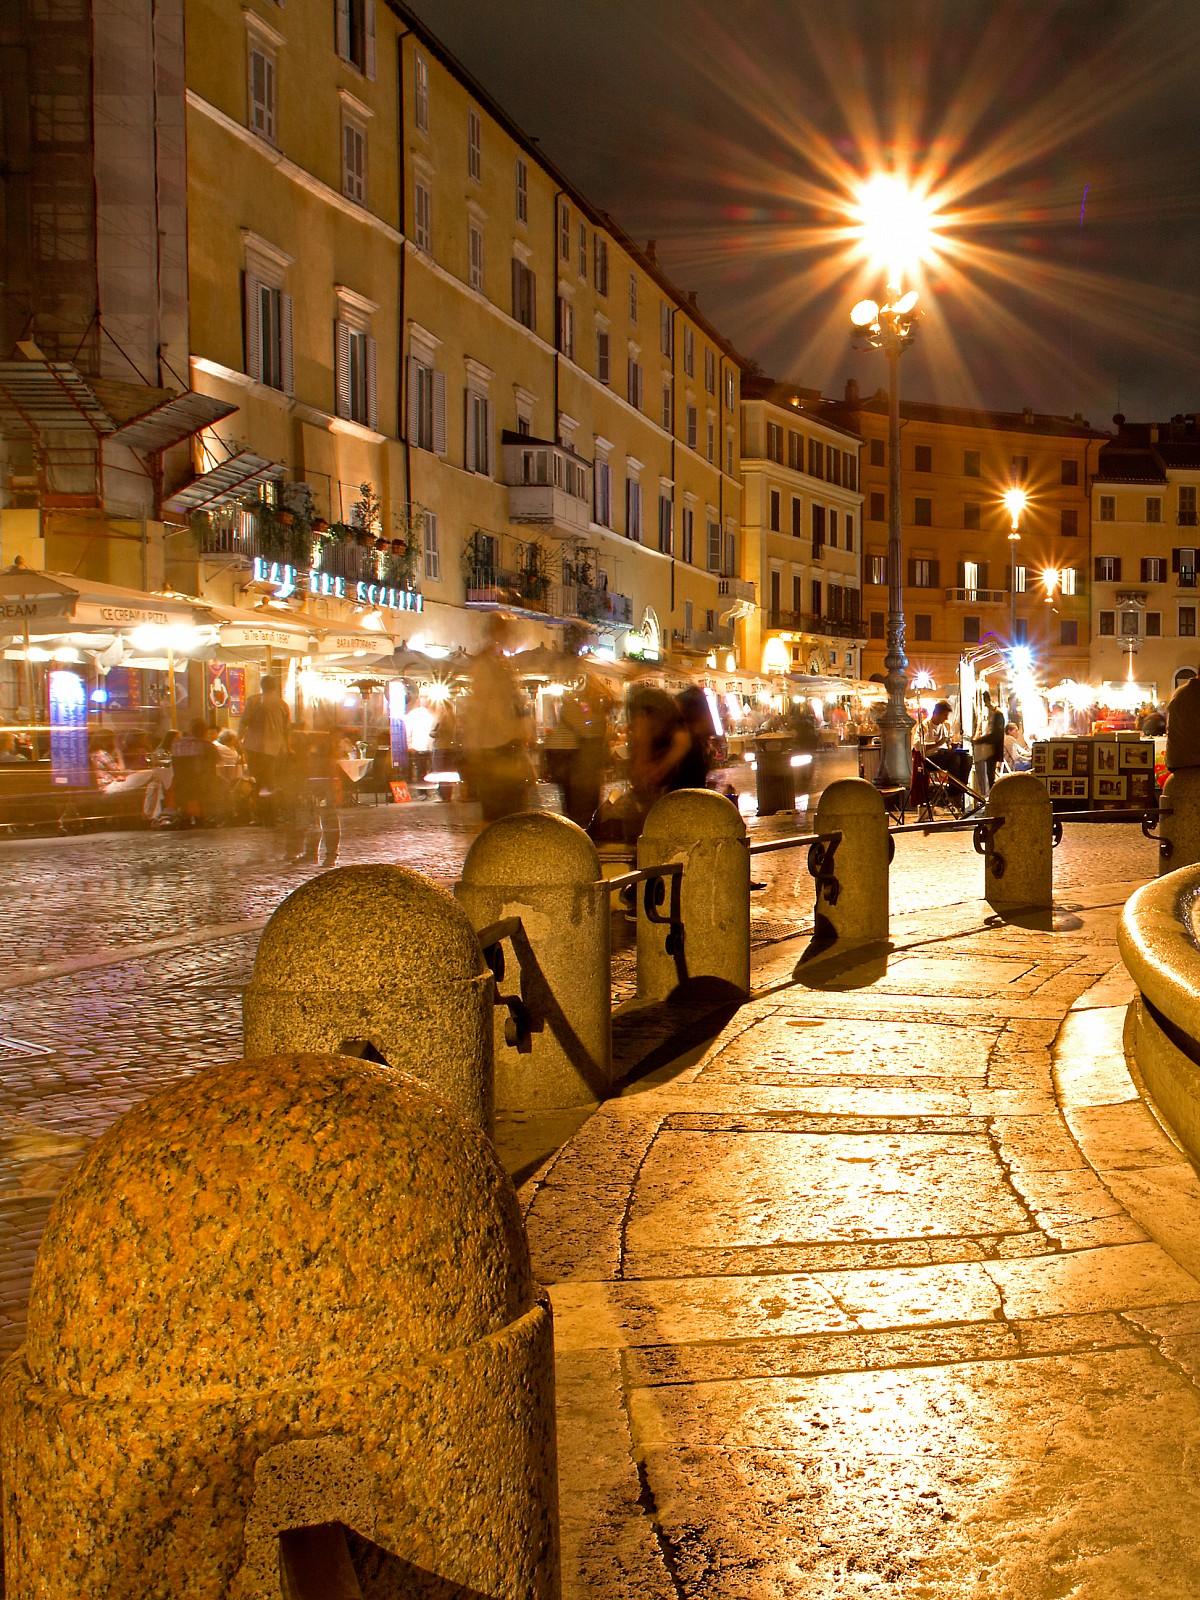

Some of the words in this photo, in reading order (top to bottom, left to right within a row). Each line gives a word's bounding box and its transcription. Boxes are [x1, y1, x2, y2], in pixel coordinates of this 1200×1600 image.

[253, 556, 297, 598] BAR
[309, 569, 346, 598] TRE
[99, 608, 114, 621] ICE
[114, 608, 140, 622] CREAM
[148, 611, 169, 625] PIZZA
